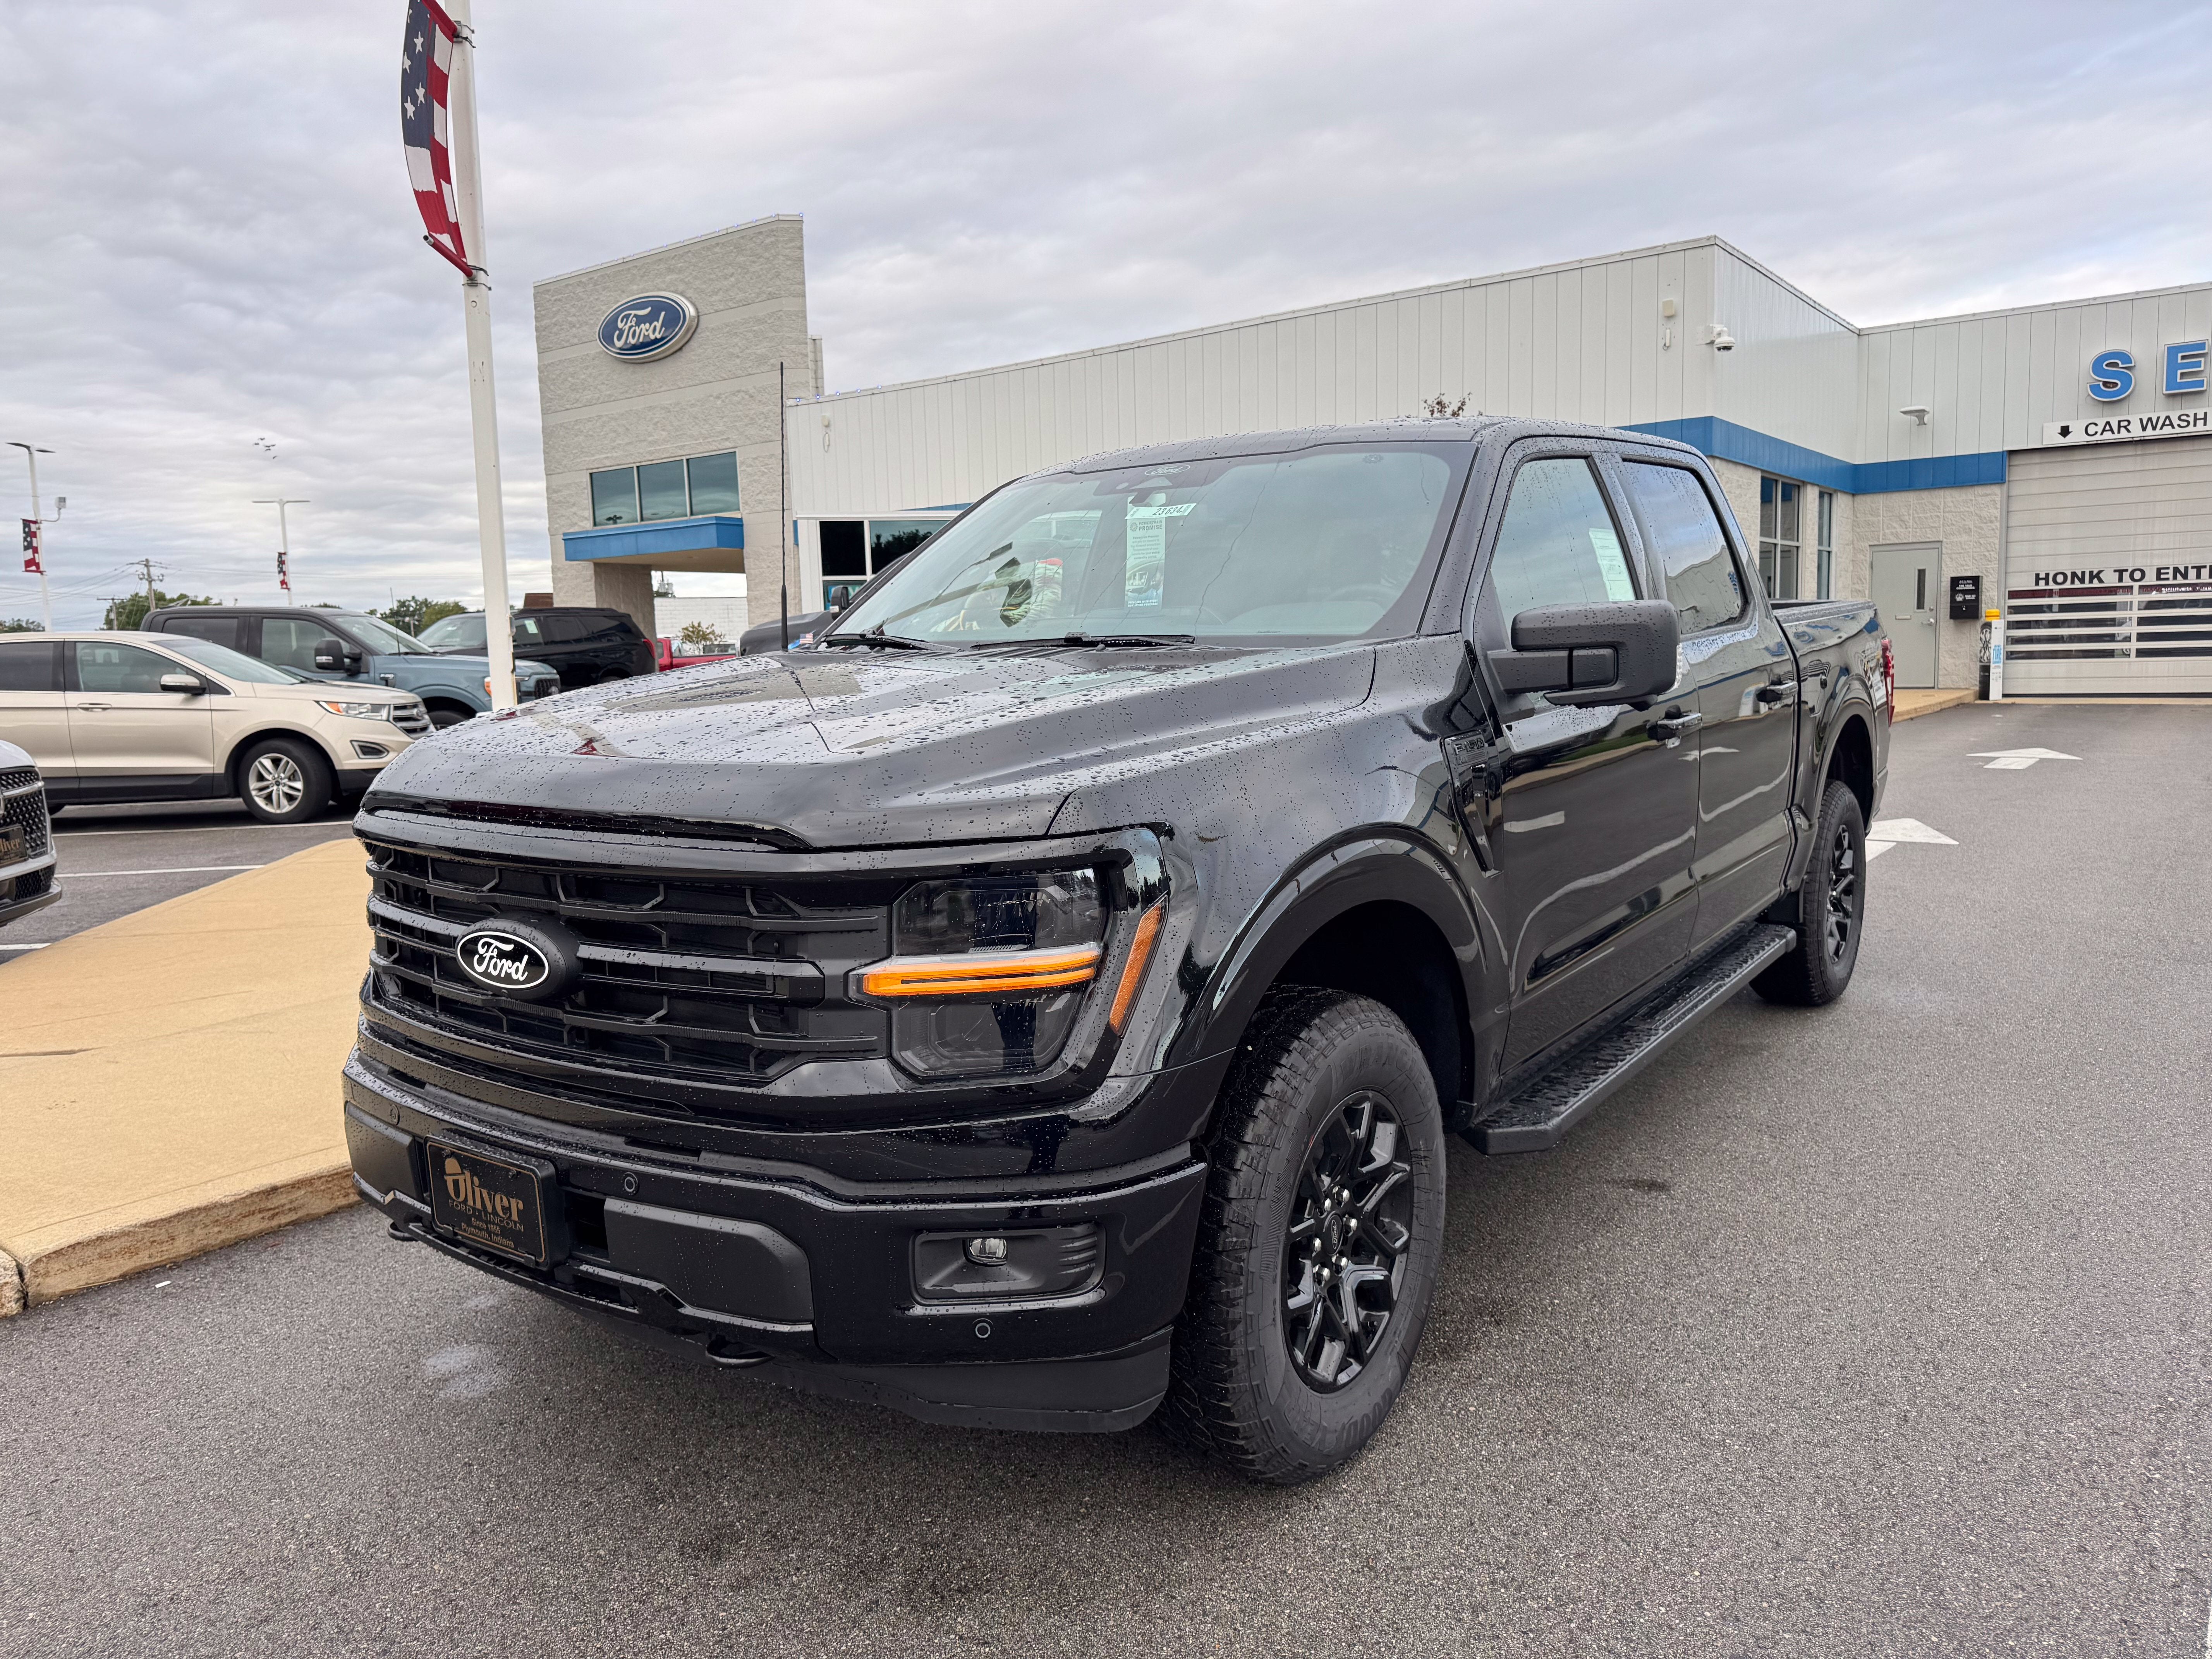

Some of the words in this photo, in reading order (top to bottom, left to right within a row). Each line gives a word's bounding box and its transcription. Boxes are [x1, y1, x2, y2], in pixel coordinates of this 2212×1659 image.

[614, 307, 665, 348] Ford
[2084, 419, 2131, 437] CAR
[2139, 411, 2208, 432] WASH
[1151, 466, 1184, 474] Ford
[2035, 570, 2106, 586] HONK
[2113, 568, 2146, 583] TO
[0, 838, 19, 852] liver
[473, 938, 529, 981] Ford
[444, 1158, 524, 1222] Oliver
[449, 1199, 472, 1214] FORD
[482, 1211, 524, 1232] LINCOLN
[472, 1217, 486, 1229] Since
[488, 1224, 501, 1234] 1955
[461, 1222, 490, 1240] Plymouth,
[491, 1233, 514, 1248] Indiana
